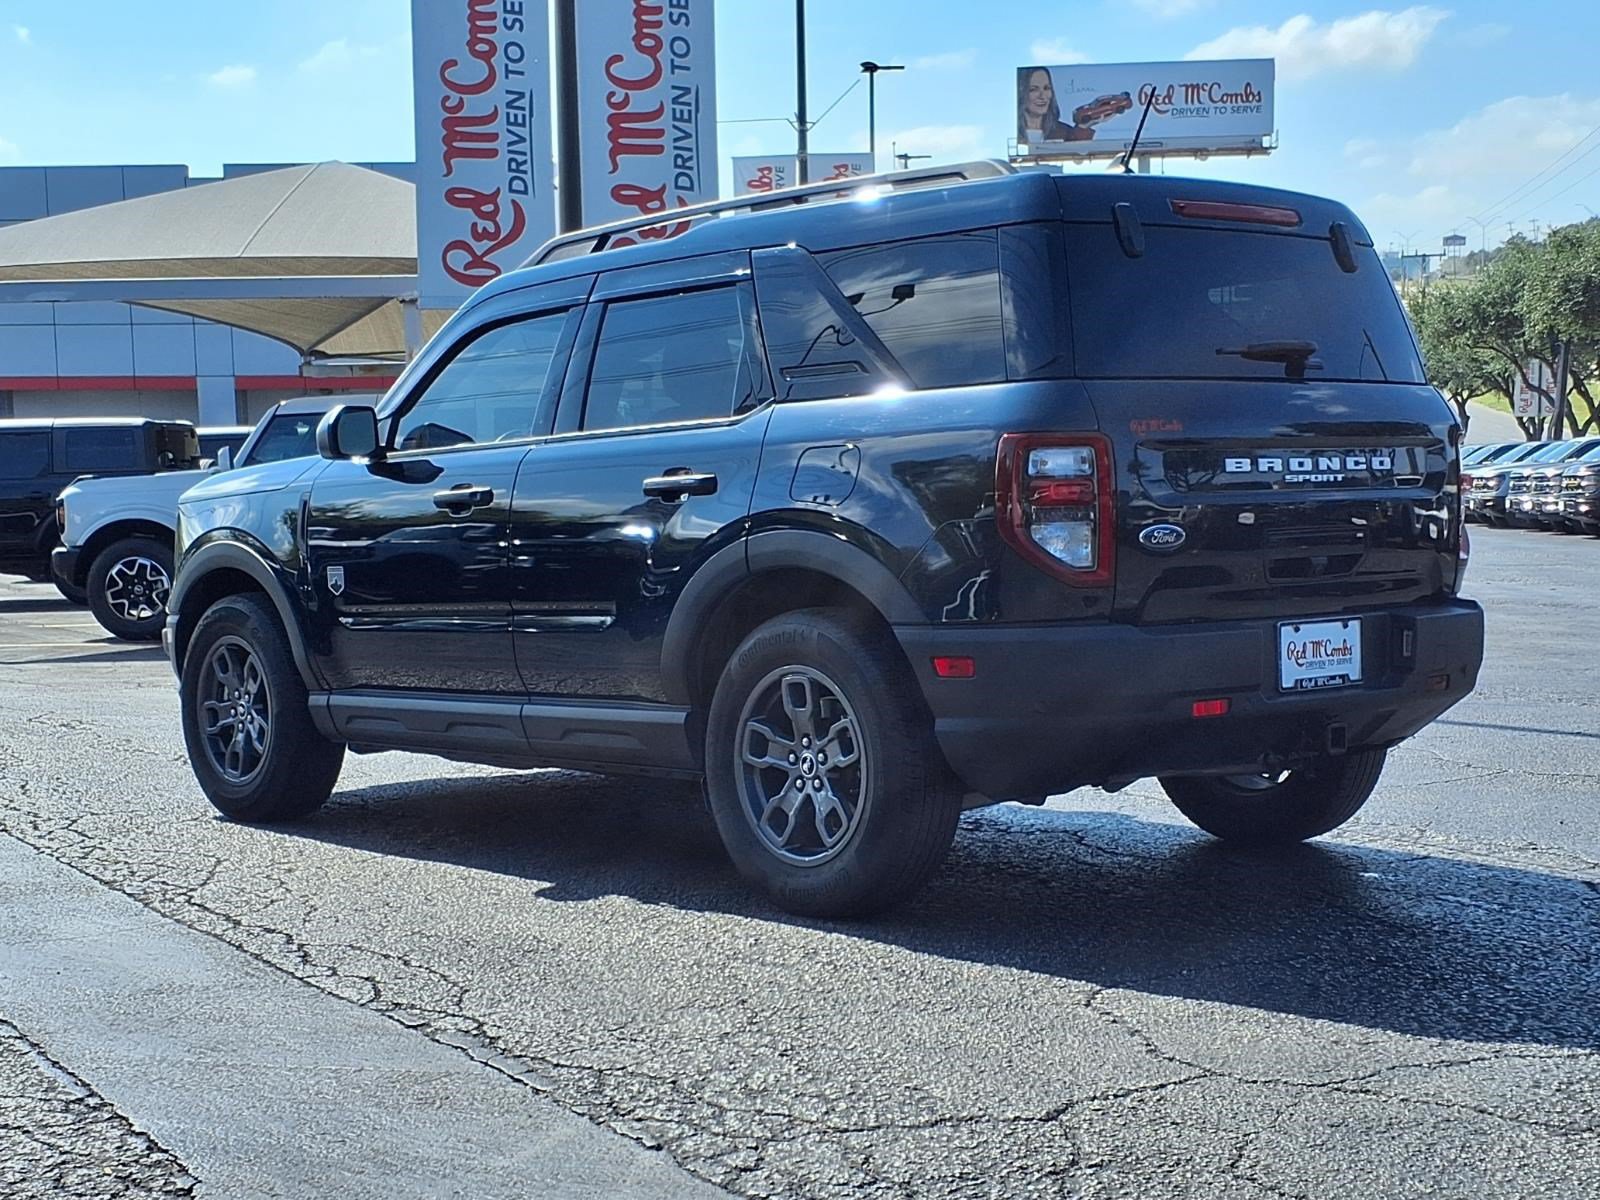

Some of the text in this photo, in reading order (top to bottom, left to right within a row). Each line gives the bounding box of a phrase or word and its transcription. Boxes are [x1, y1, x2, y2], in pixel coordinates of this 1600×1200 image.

[503, 41, 525, 80] TO
[669, 35, 691, 75] TO
[1137, 82, 1262, 115] Red McCombs
[1171, 104, 1263, 117] DRIVEN TO SERVE
[505, 89, 529, 196] DRIVEN
[671, 85, 695, 192] DRIVEN
[606, 183, 694, 250] ed
[441, 186, 527, 288] Red
[1224, 456, 1392, 473] BRONCO
[1284, 473, 1345, 483] SPORT
[1151, 529, 1177, 544] Ford
[1286, 638, 1353, 667] Red McCombs
[1305, 657, 1353, 669] DRIVEN TO SERVE
